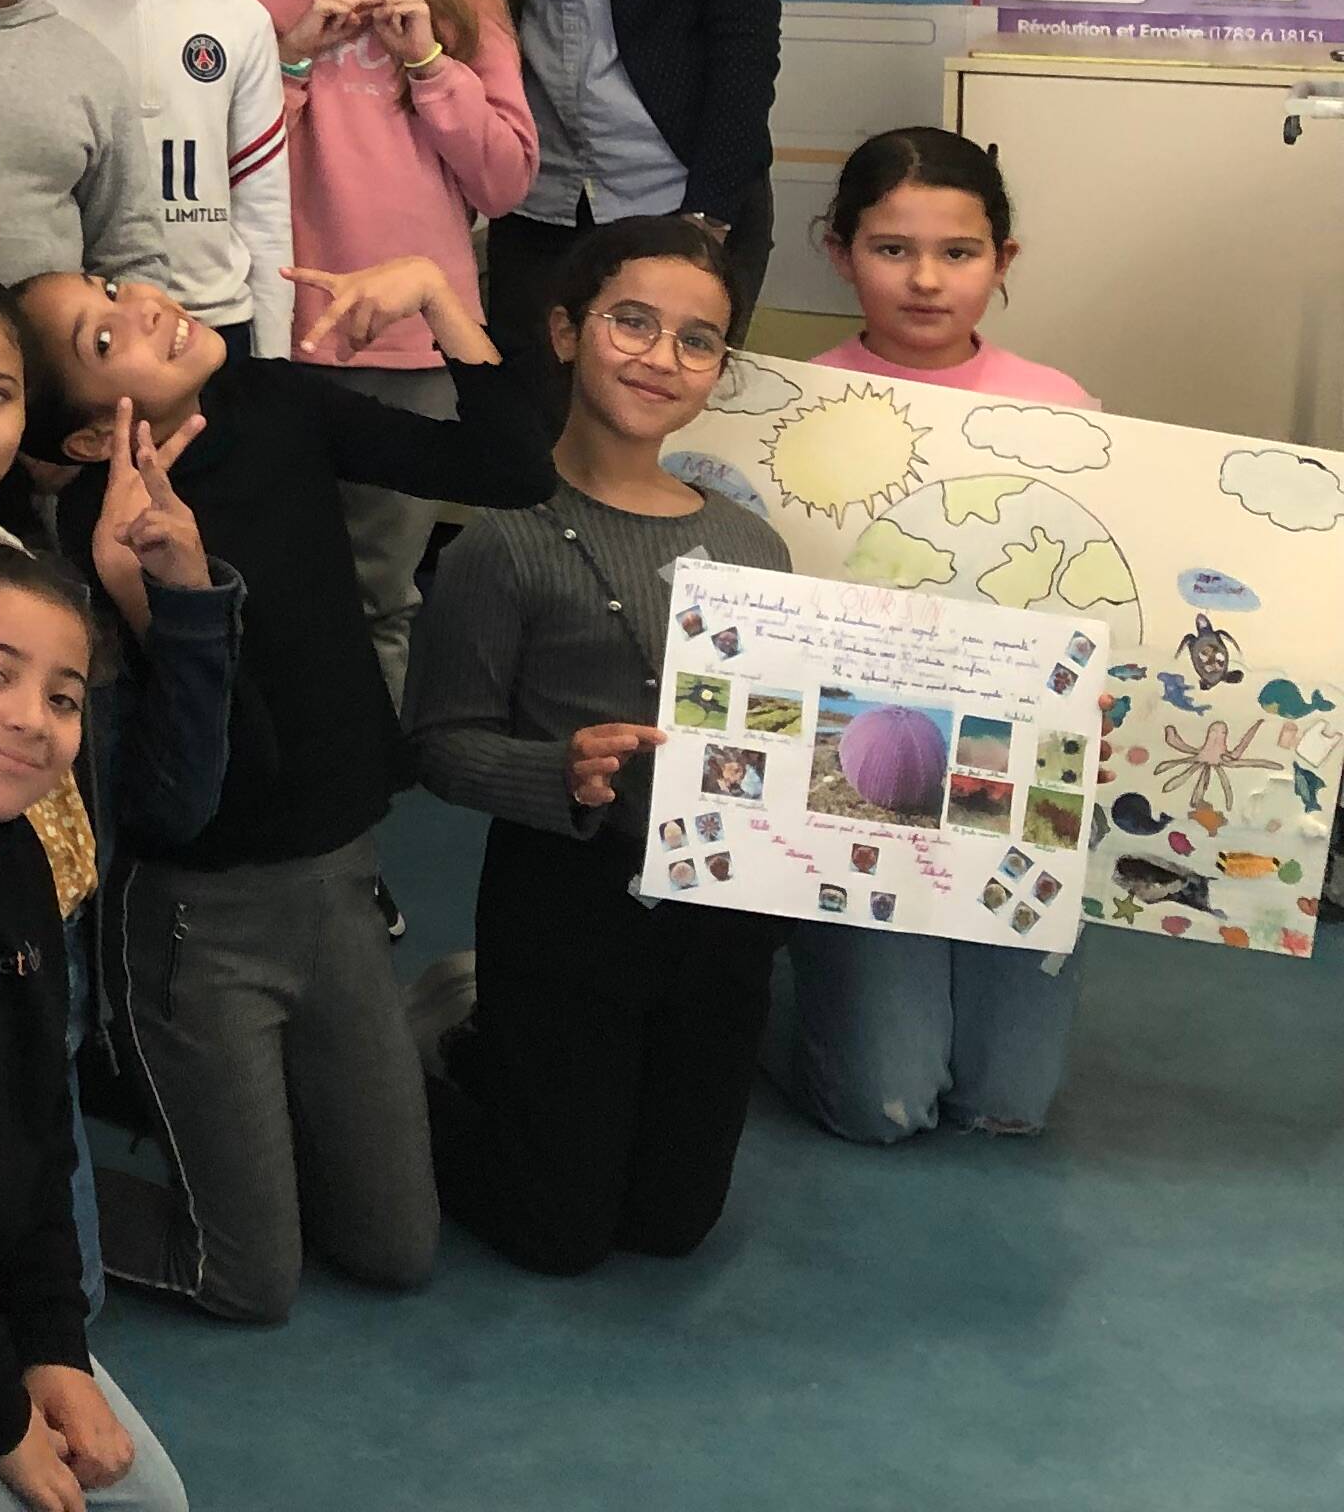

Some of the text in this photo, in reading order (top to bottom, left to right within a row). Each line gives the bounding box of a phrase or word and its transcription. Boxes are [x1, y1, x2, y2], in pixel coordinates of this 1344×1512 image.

[1018, 19, 1111, 37] Révolution
[1116, 21, 1136, 38] et
[1139, 23, 1205, 39] Empire
